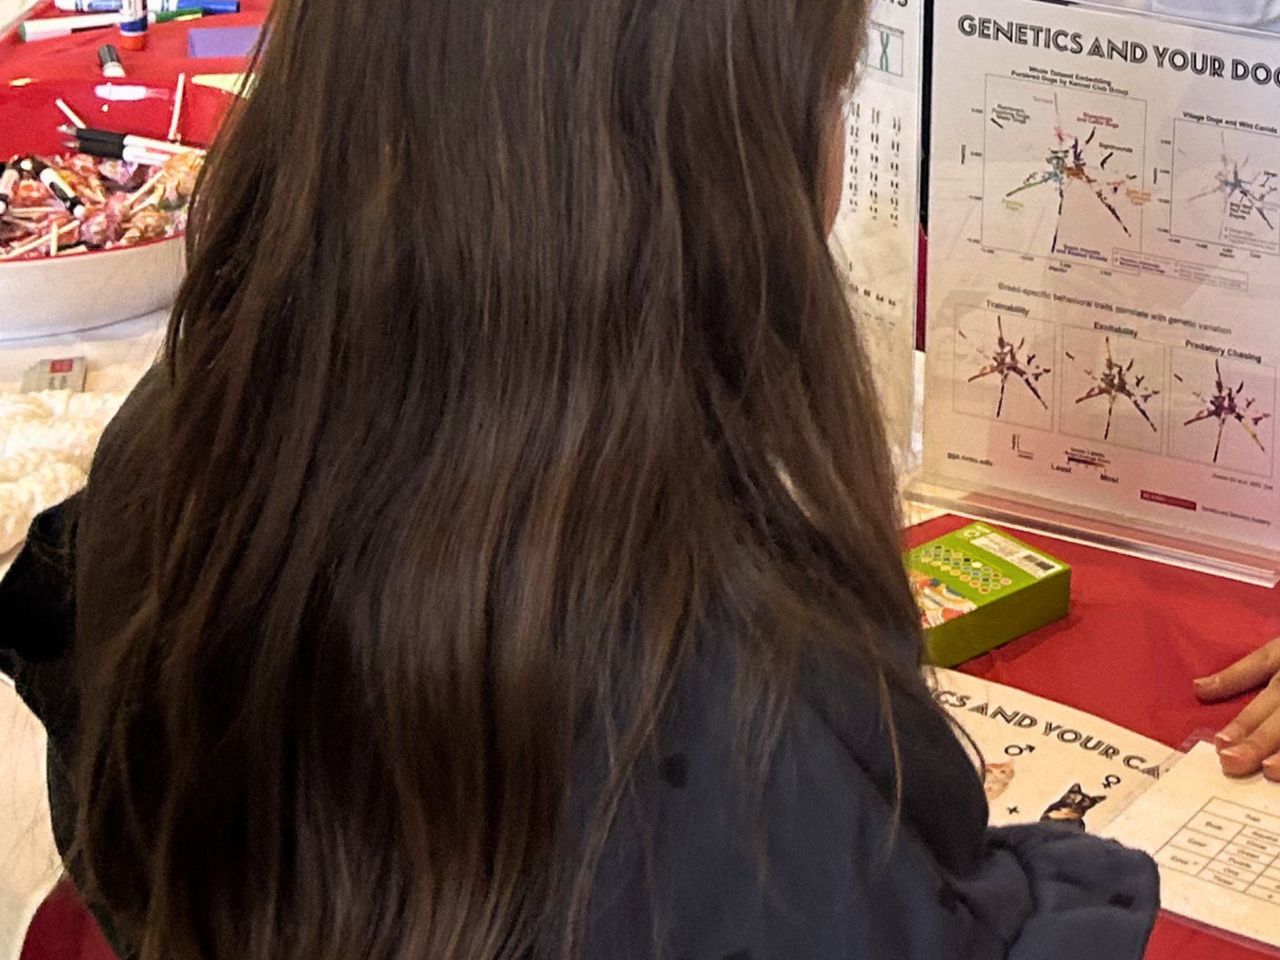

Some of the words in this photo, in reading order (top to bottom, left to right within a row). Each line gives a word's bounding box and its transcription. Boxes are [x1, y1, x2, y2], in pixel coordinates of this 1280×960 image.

[957, 14, 1084, 55] GENETICS
[1086, 37, 1148, 64] AND
[1152, 44, 1226, 79] YOUR
[986, 299, 1030, 317] Trainability
[1185, 339, 1225, 356] Predatory
[1227, 348, 1262, 364] Chasing
[967, 701, 1038, 730] AND
[1042, 720, 1121, 762] YOUR
[1122, 753, 1171, 781] CA
